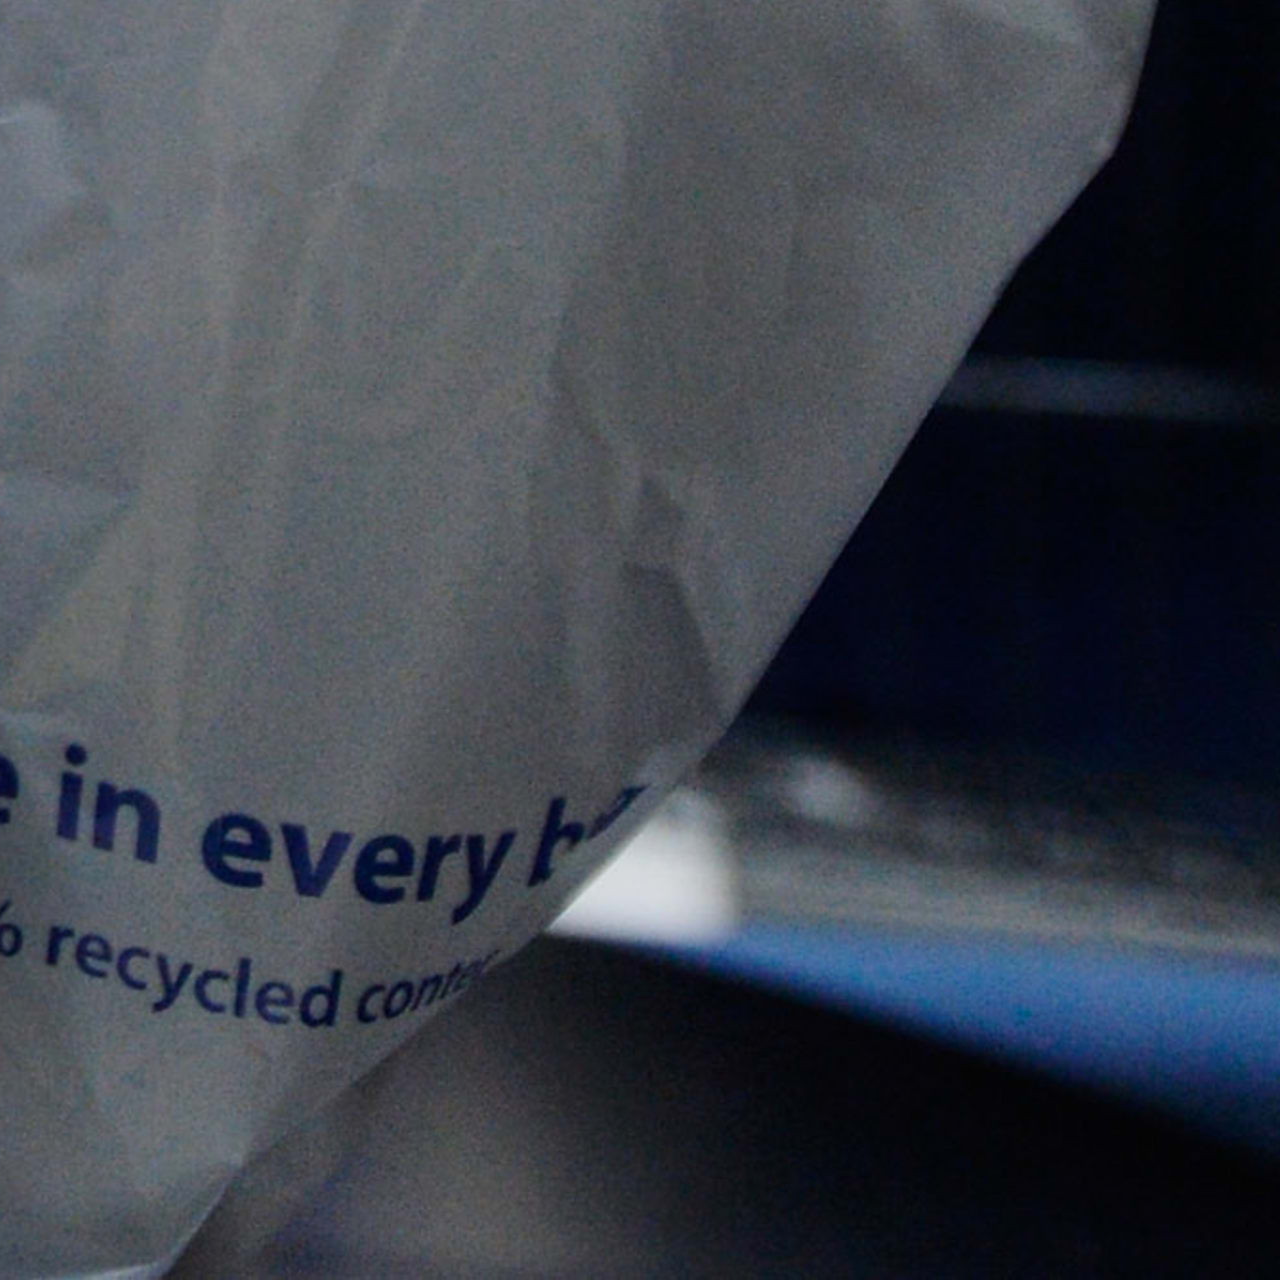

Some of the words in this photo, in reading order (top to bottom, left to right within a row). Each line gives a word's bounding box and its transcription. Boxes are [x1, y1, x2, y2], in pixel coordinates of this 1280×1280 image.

[55, 741, 162, 864] in
[200, 811, 518, 927] every
[45, 925, 346, 1030] recycled
